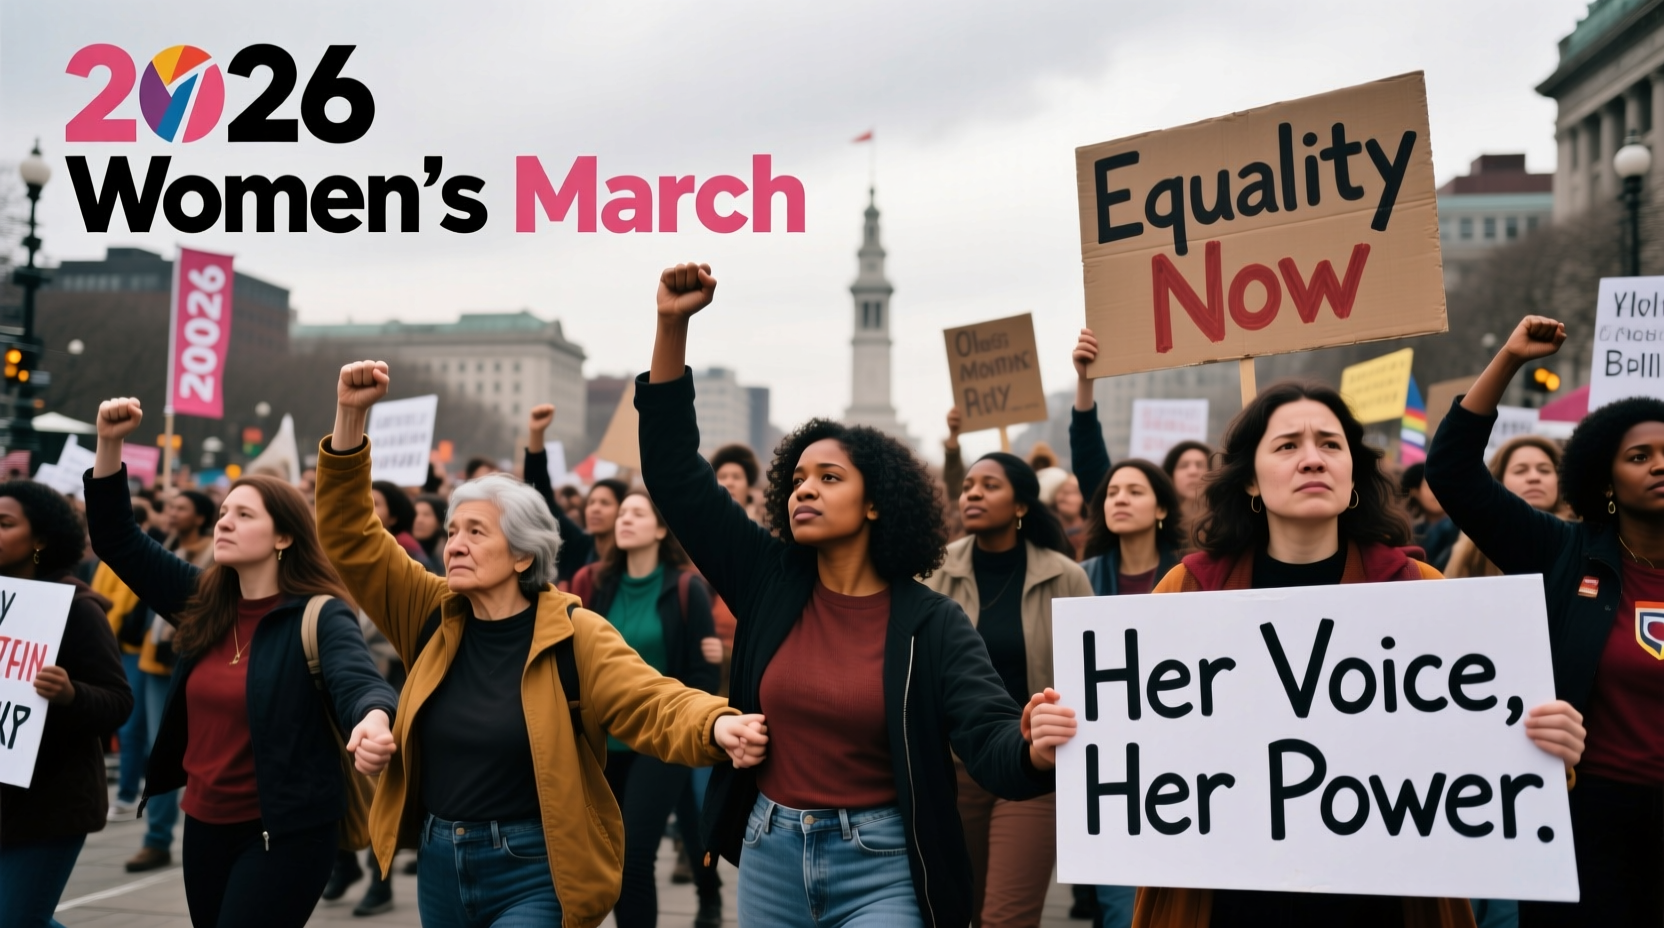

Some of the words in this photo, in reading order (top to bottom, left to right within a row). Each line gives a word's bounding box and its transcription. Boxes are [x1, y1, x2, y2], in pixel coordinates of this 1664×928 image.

[1095, 122, 1417, 256] Equality
[180, 264, 226, 403] 20026
[1153, 241, 1369, 353] Now
[1083, 629, 1236, 721] Her
[1260, 618, 1524, 727] Voice,
[1086, 743, 1235, 835] Her
[1268, 738, 1556, 843] Power.
